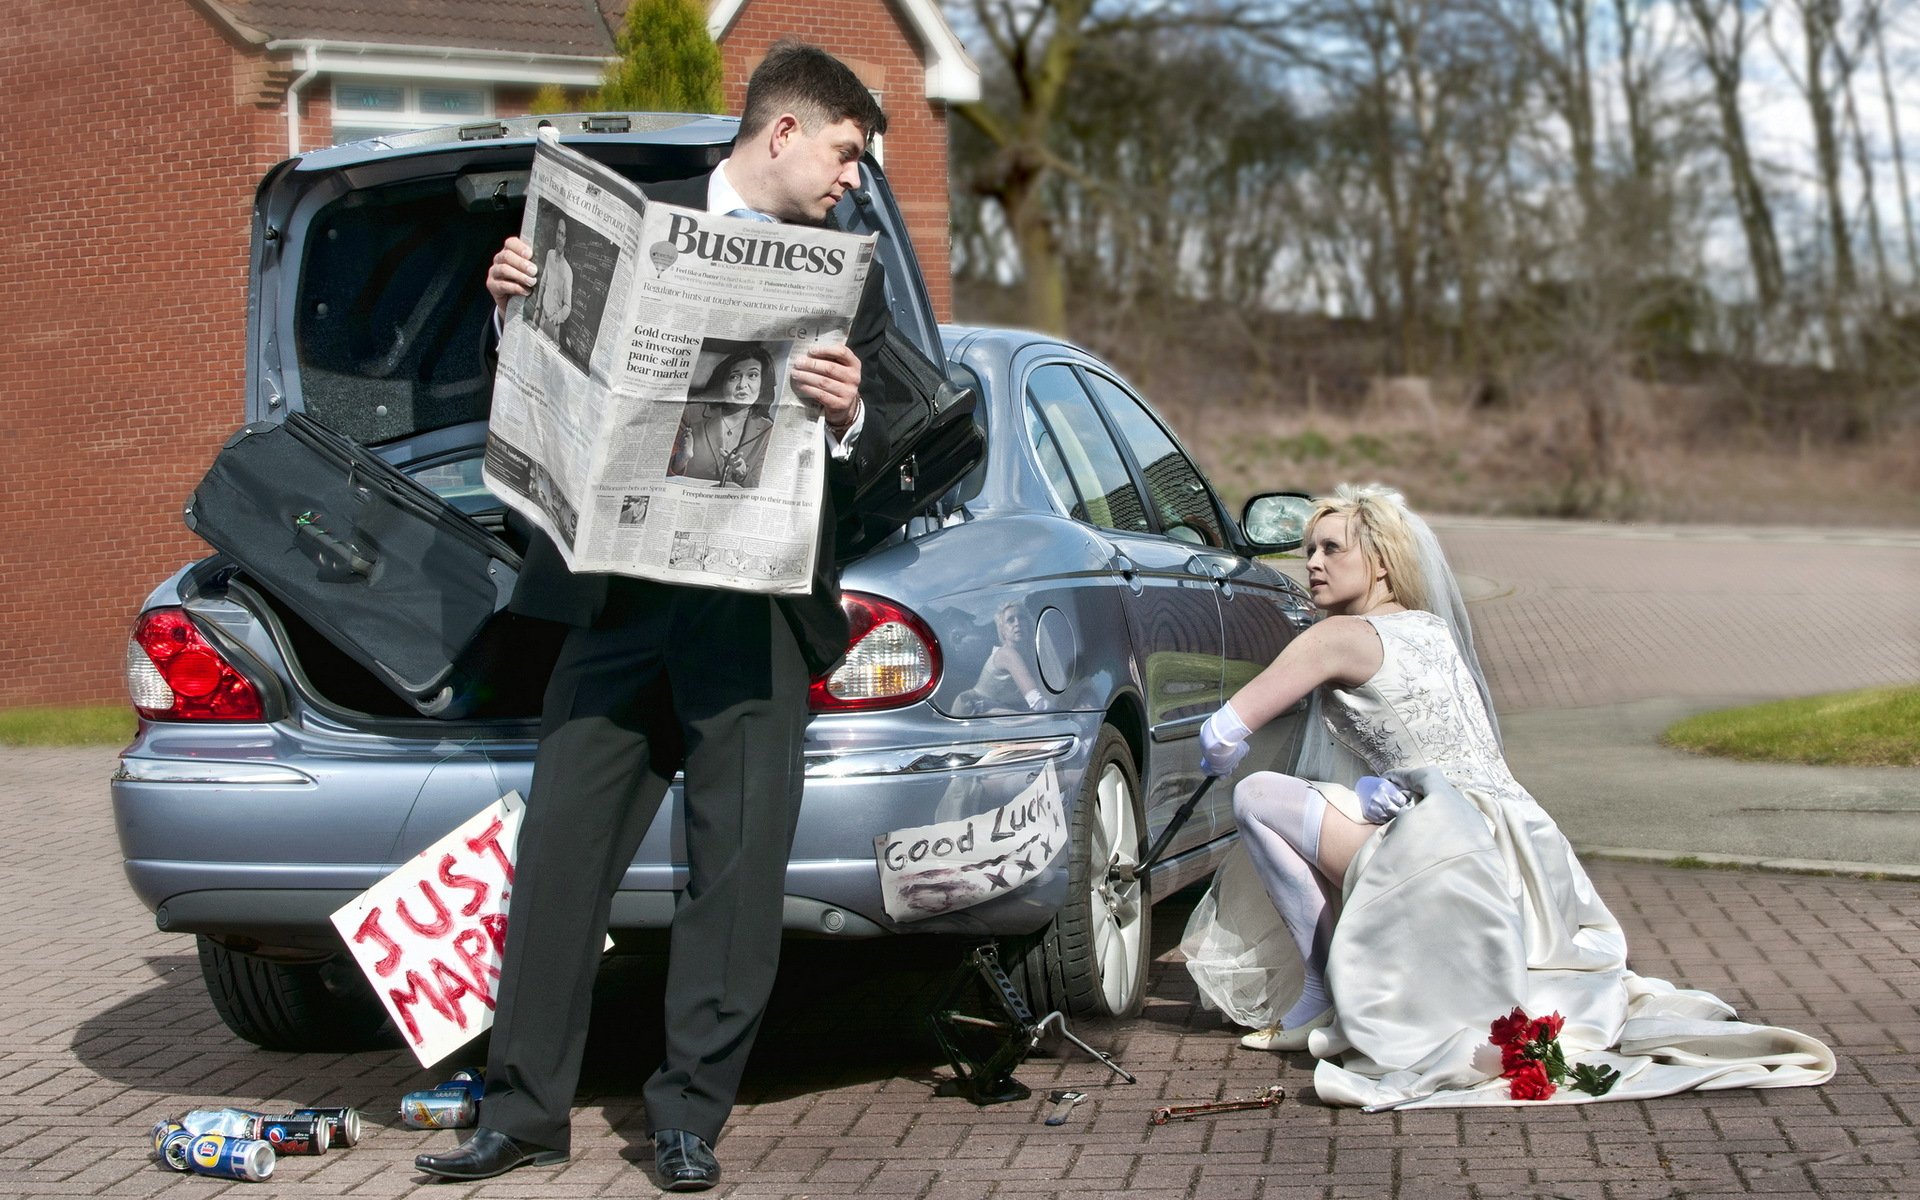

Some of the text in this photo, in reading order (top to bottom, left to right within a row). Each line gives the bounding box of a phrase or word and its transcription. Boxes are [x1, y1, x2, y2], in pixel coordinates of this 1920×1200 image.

[549, 176, 560, 192] has
[566, 190, 580, 205] feet
[581, 200, 591, 211] on
[592, 203, 603, 218] the
[604, 213, 627, 232] ground
[668, 212, 846, 276] Business
[644, 282, 681, 296] Regulator
[682, 290, 702, 300] hints
[712, 297, 742, 306] tougher
[743, 301, 777, 310] sanctions
[779, 303, 790, 311] for
[791, 304, 809, 314] bank
[811, 306, 837, 315] failures
[632, 339, 692, 356] as investors
[634, 325, 700, 345] Gold crashes
[627, 361, 688, 379] bear market
[629, 352, 690, 367] panic sell in
[683, 489, 714, 499] Freephone
[884, 769, 1051, 872] Good Luck!
[353, 816, 515, 978] JUST
